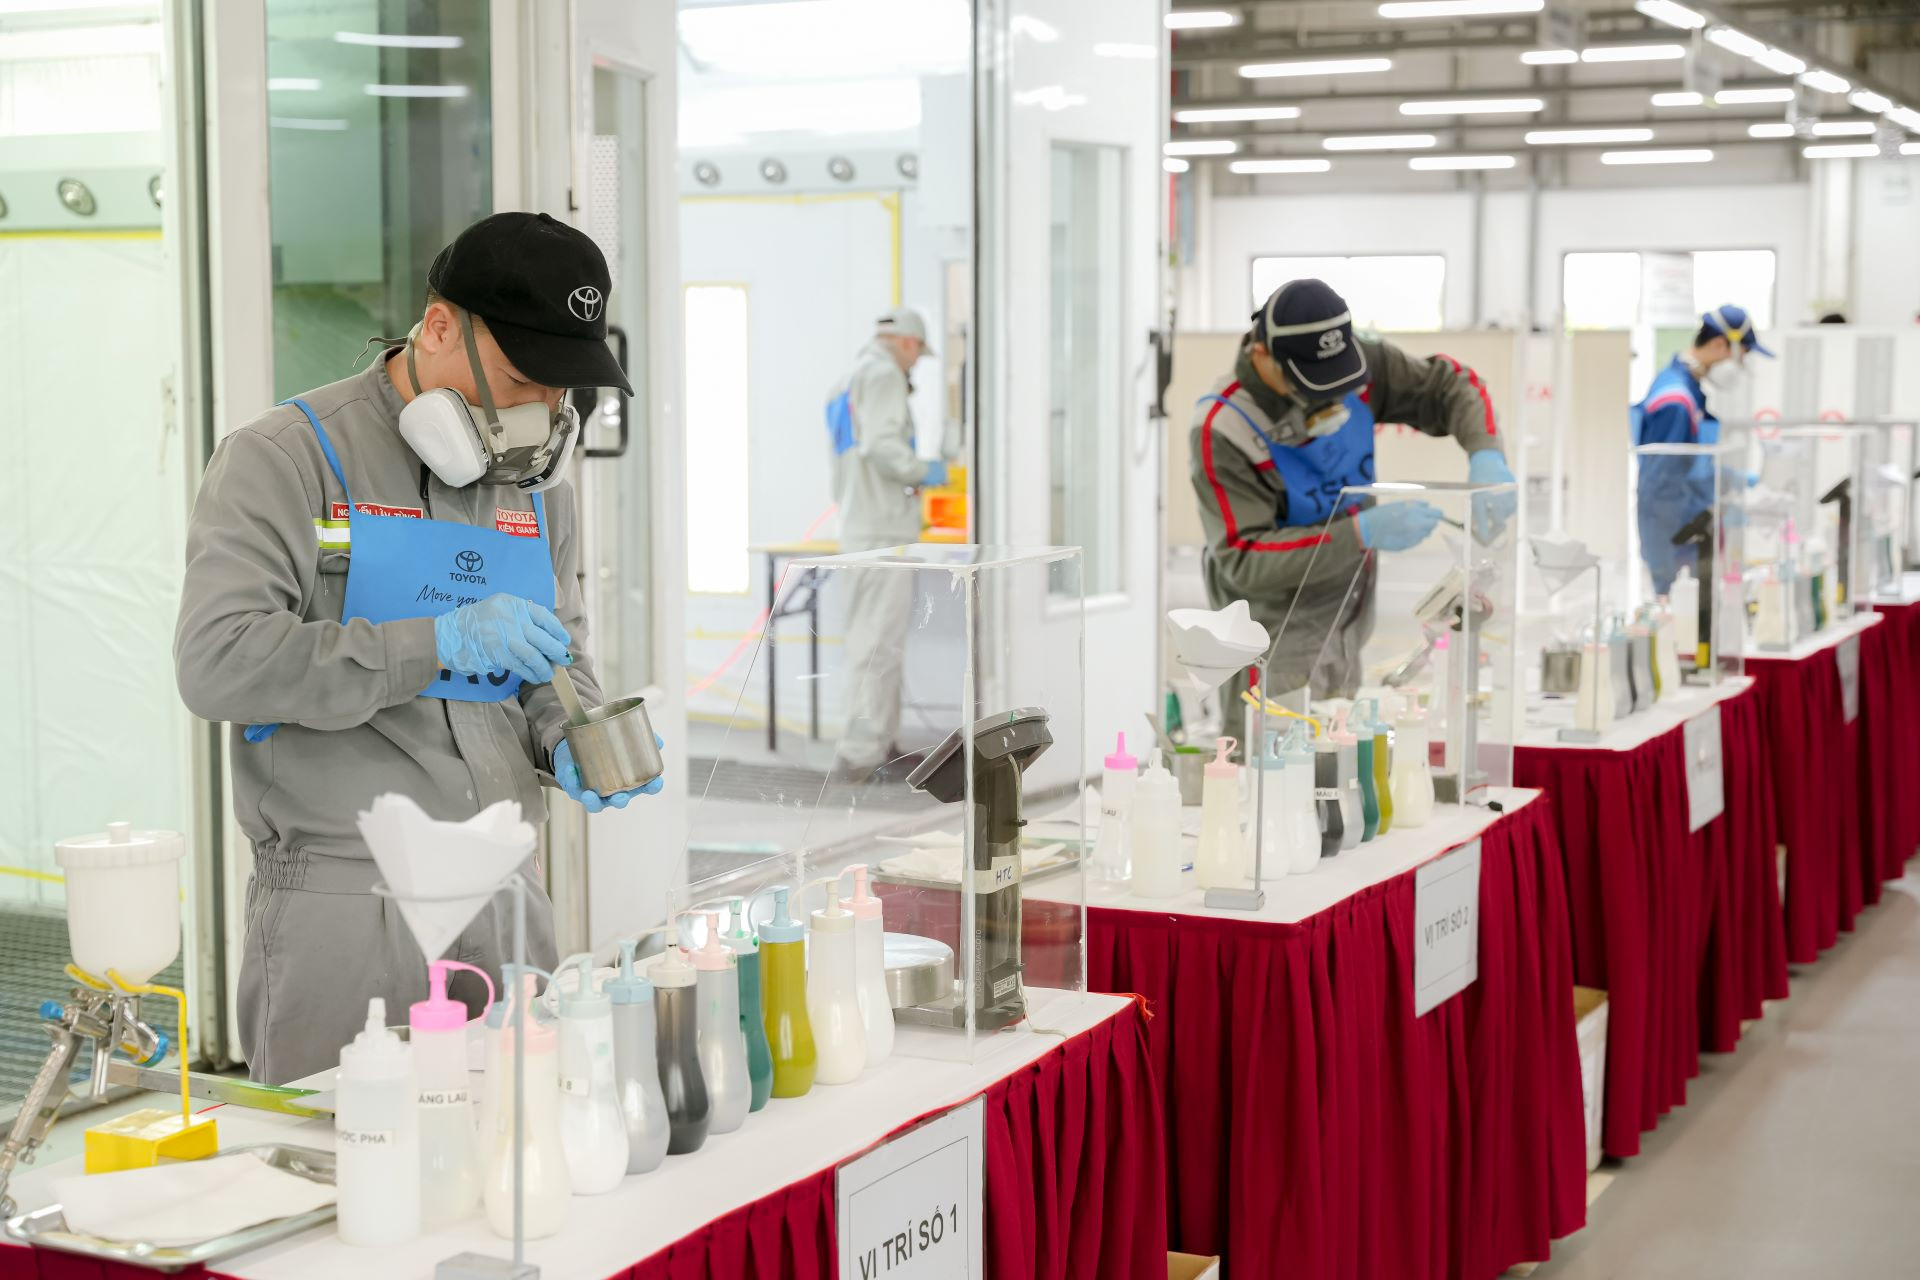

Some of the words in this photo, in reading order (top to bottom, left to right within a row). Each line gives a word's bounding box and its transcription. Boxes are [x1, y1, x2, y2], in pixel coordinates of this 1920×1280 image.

[497, 510, 538, 523] TOYOTA
[449, 572, 487, 585] TOYOTA
[416, 584, 454, 604] Move
[457, 595, 484, 609] you
[882, 1219, 913, 1271] TRÍ
[918, 1204, 944, 1252] SỐ
[949, 1202, 957, 1233] 1
